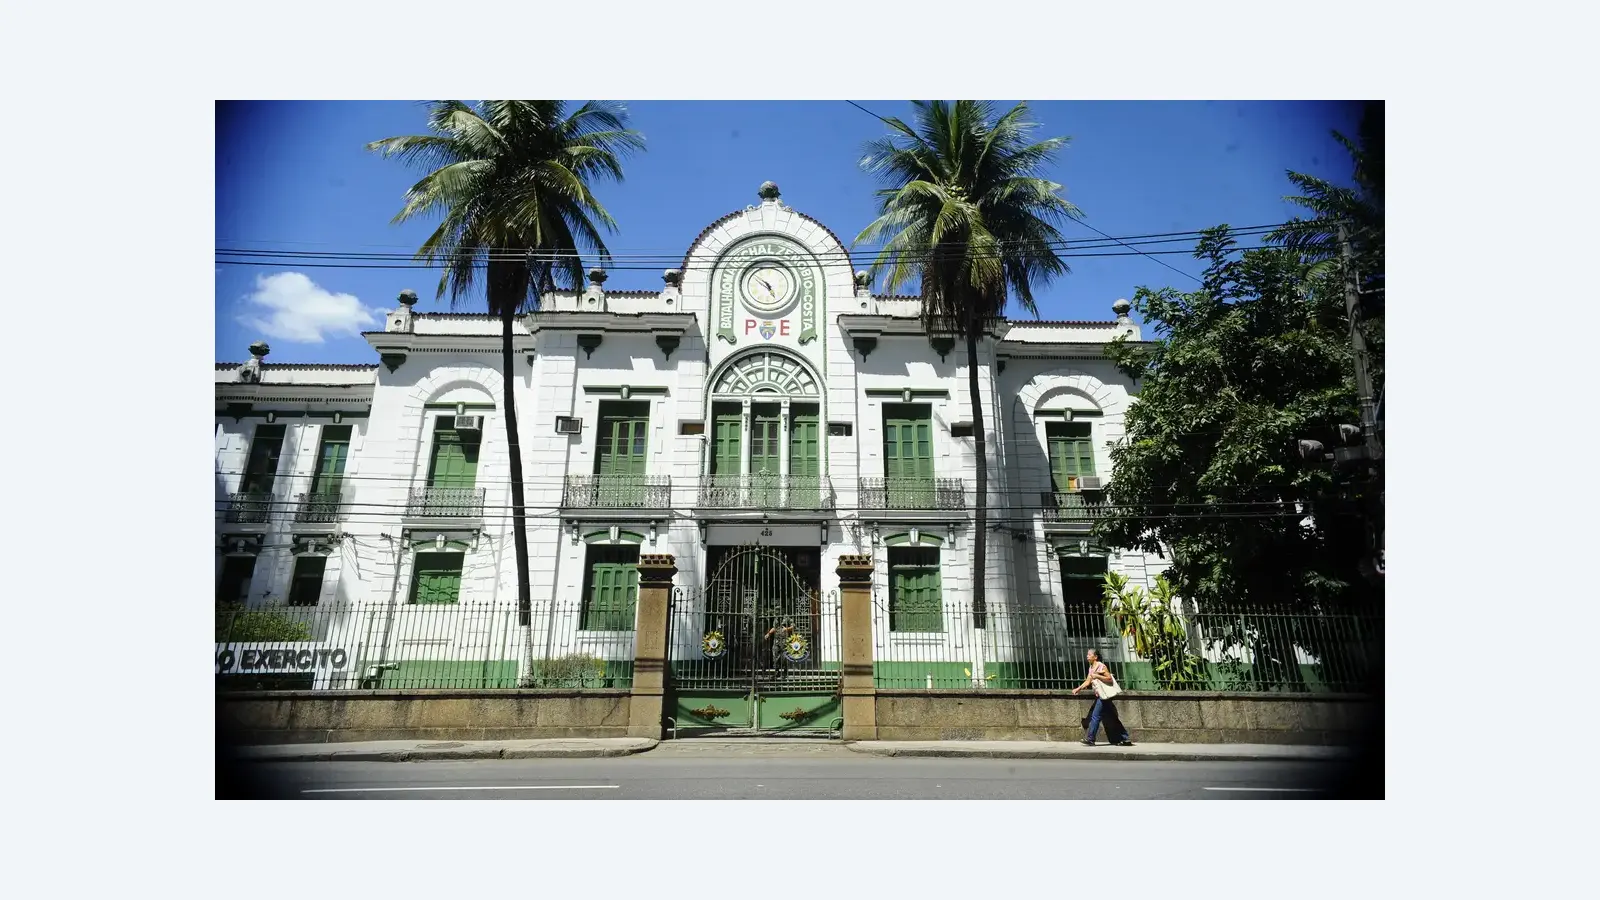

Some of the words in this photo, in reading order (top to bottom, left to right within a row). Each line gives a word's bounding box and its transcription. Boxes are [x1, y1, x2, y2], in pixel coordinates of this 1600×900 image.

[803, 294, 813, 331] COSTA
[745, 319, 757, 335] P
[780, 319, 790, 336] E
[215, 650, 236, 670] O
[240, 648, 347, 669] EXERCITO
